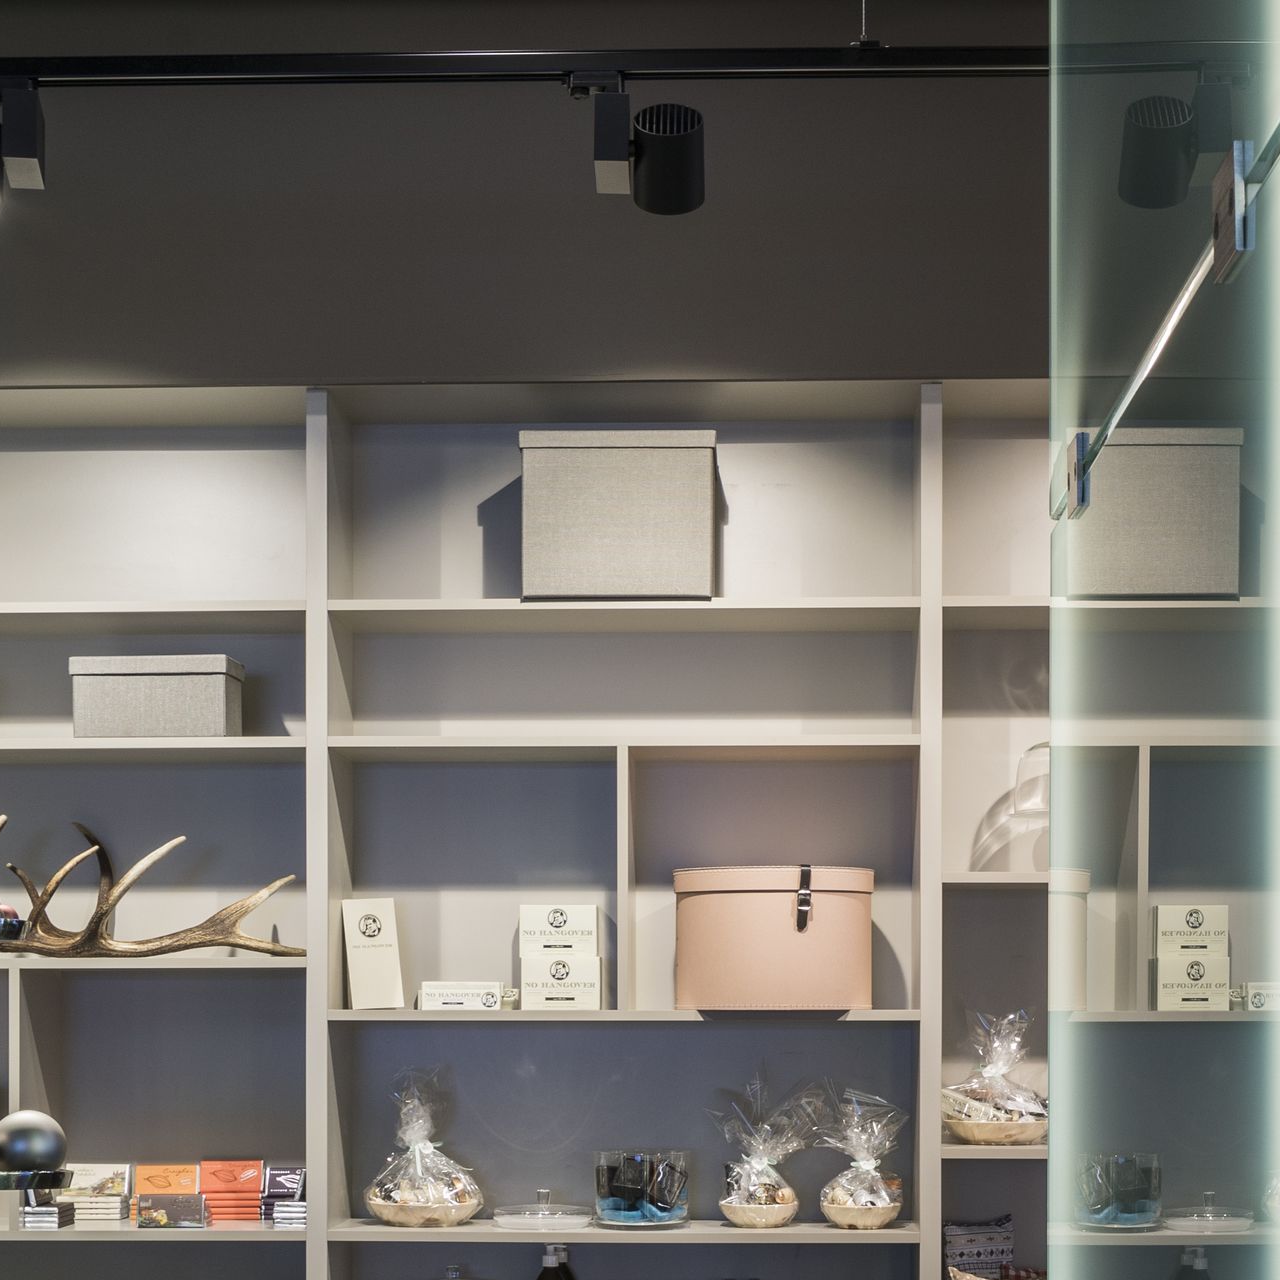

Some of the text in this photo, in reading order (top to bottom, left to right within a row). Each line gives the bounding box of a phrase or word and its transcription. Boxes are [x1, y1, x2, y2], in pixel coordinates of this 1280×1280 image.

[522, 929, 593, 937] NO HANGOVER
[524, 981, 596, 989] NO HANGOVER
